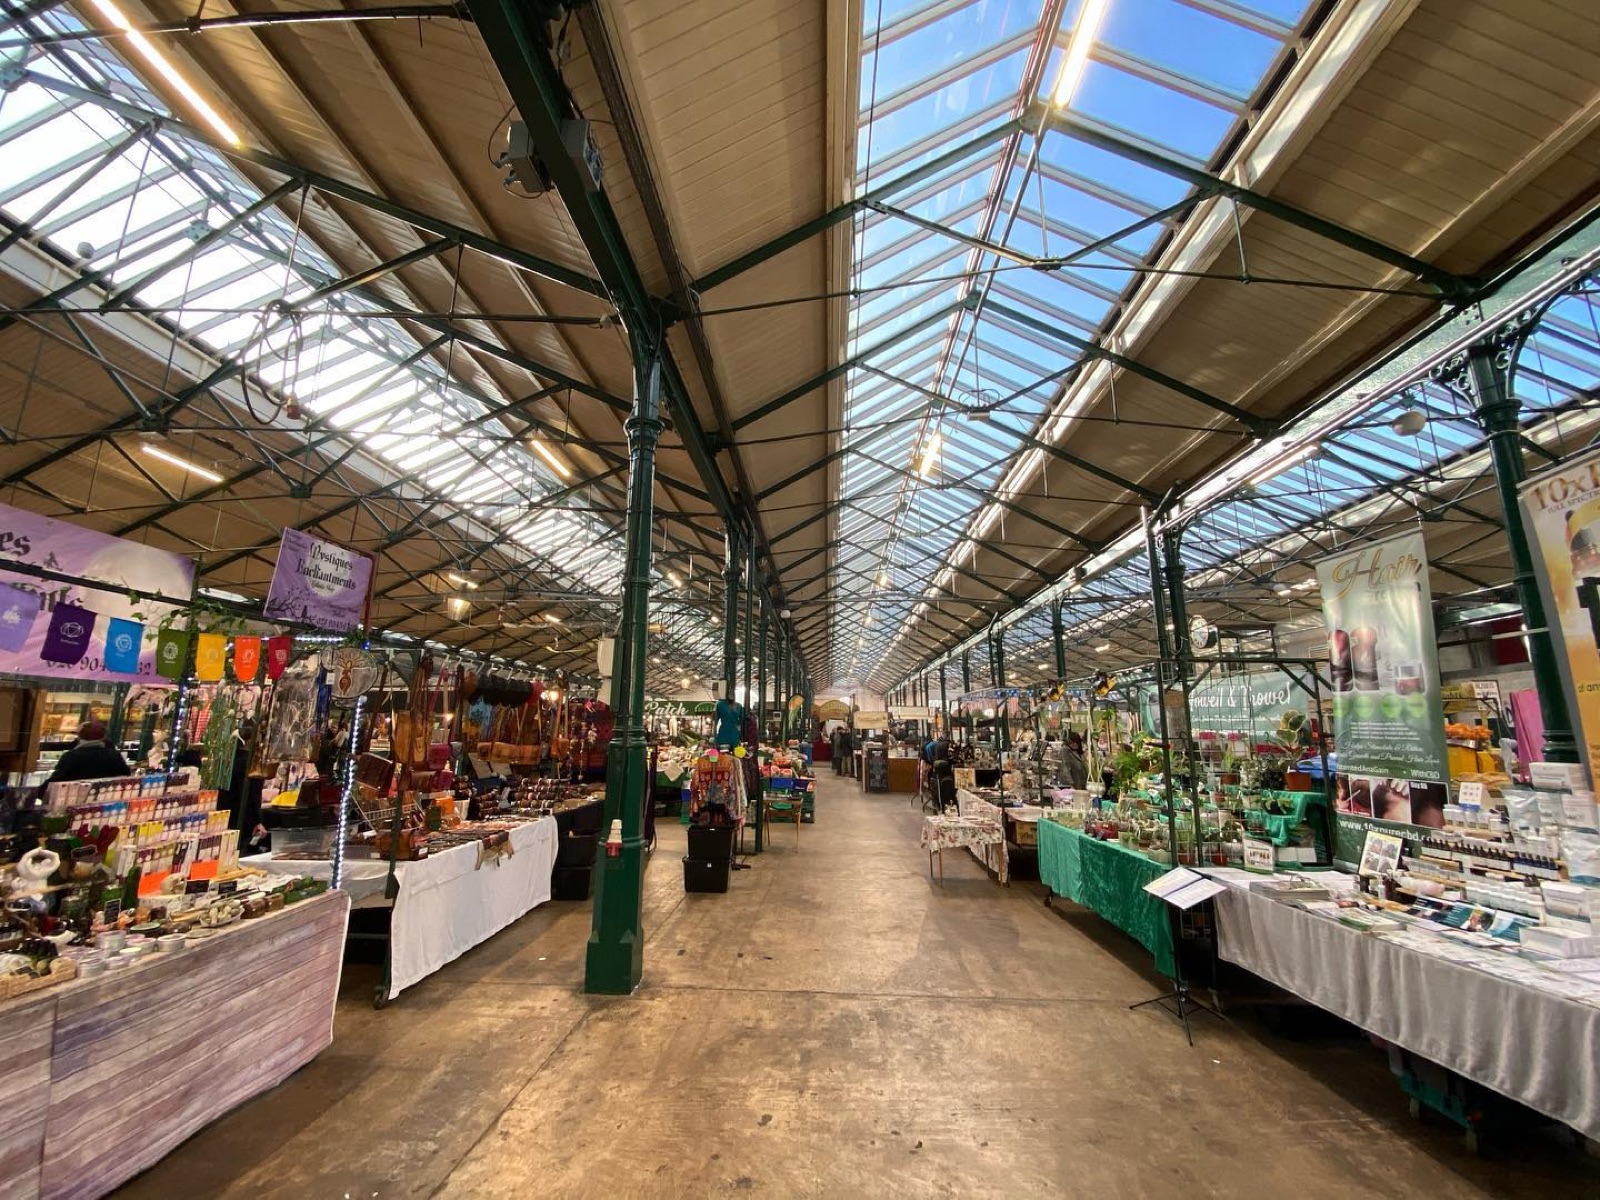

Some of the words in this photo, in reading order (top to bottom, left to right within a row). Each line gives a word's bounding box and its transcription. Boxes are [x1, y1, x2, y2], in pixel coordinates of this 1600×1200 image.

[310, 542, 353, 571] Mystiques
[296, 558, 356, 590] Enchantments
[1333, 548, 1418, 601] Hair
[644, 701, 690, 717] Patch
